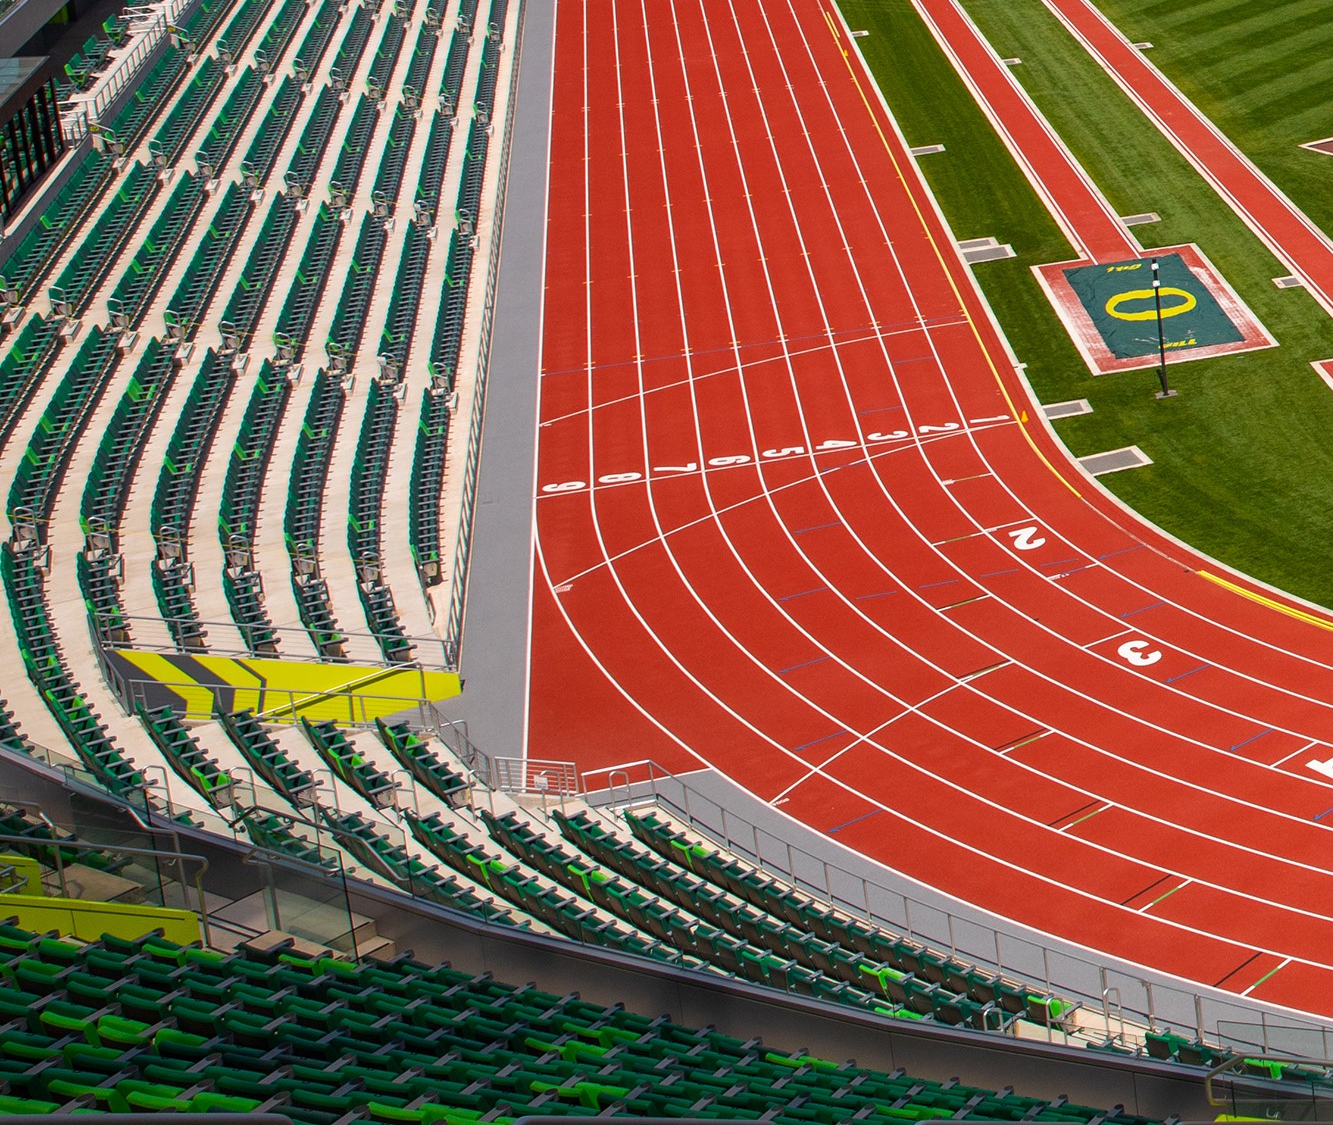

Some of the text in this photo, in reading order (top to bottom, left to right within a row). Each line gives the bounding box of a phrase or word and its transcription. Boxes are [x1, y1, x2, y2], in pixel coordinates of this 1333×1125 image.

[542, 415, 1010, 492] 9 8 7 6 5 4 3 2 1
[1008, 526, 1046, 550] 2
[1117, 640, 1162, 666] 3
